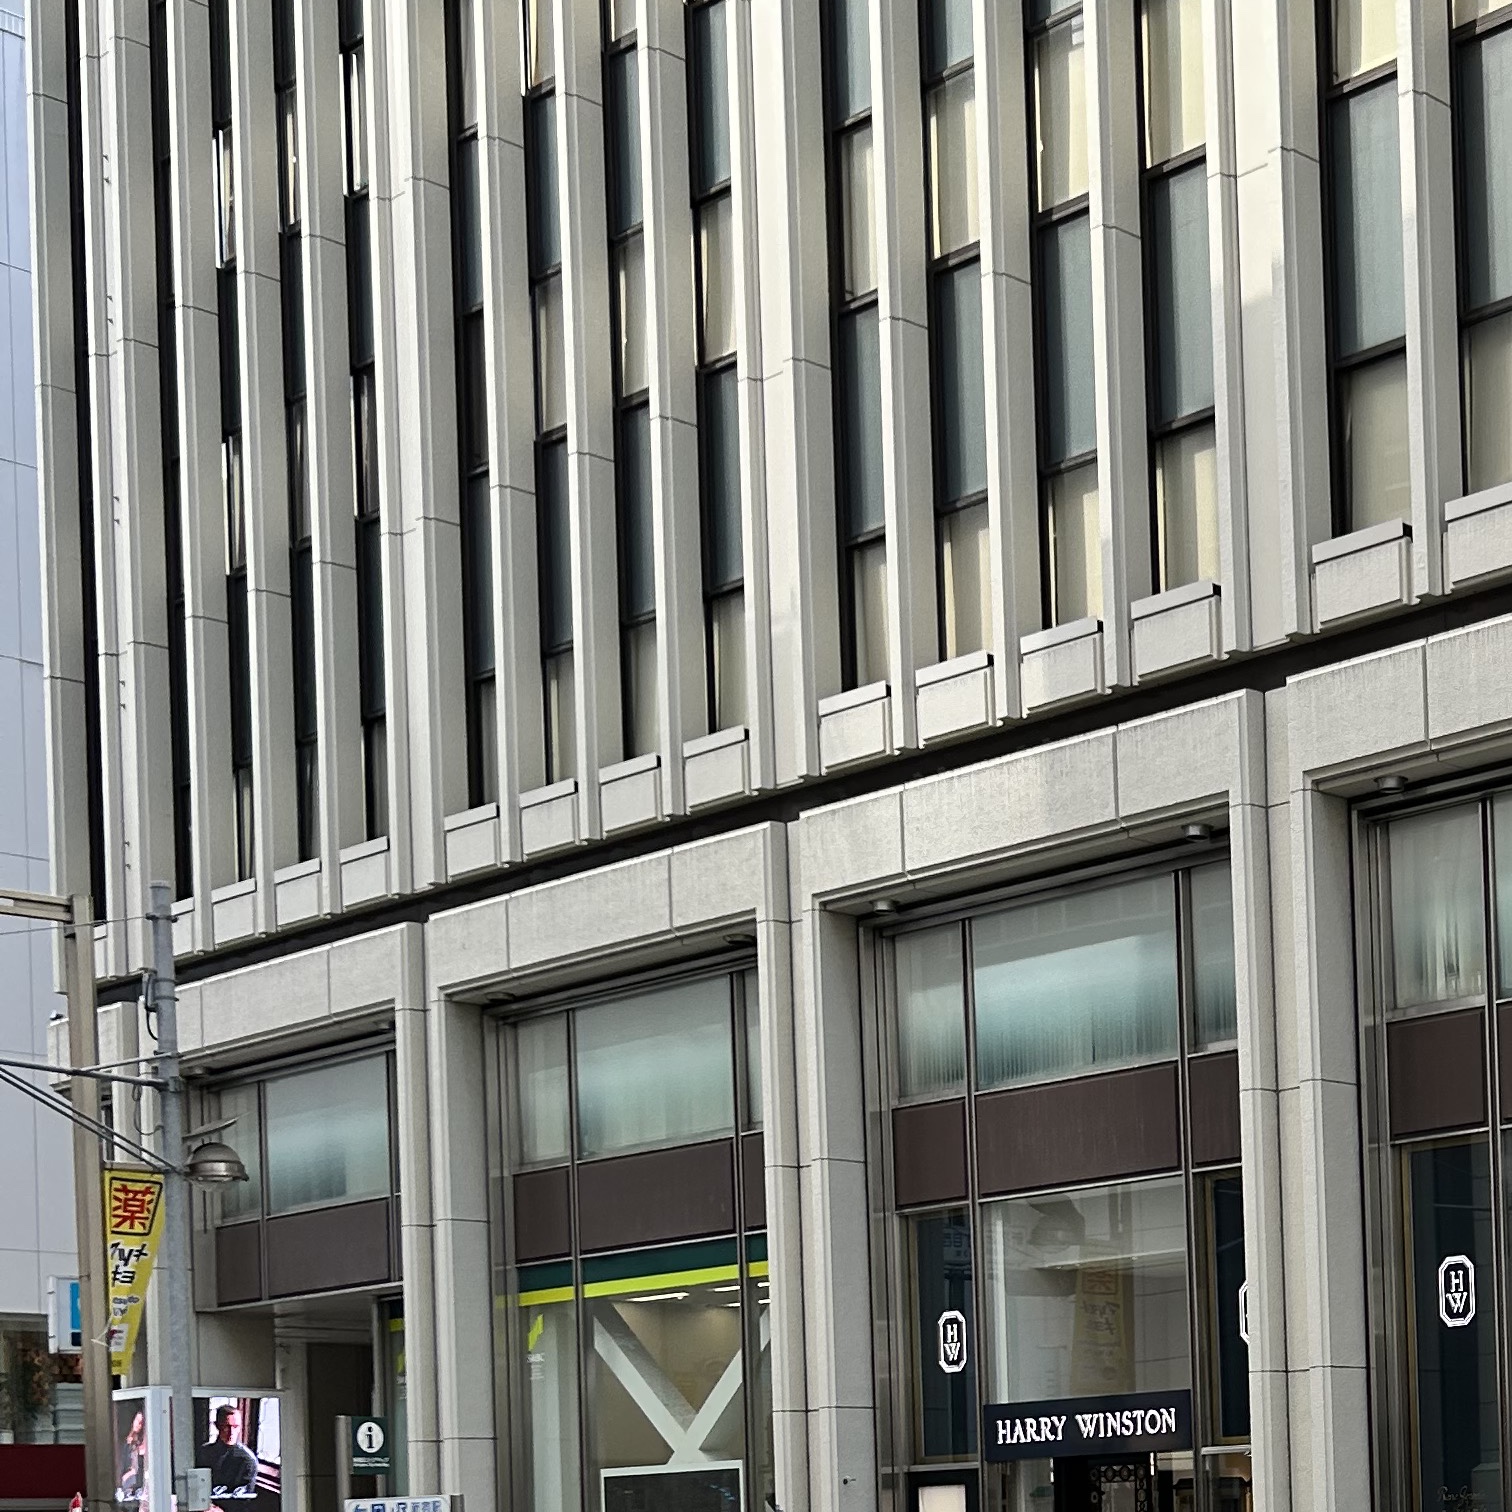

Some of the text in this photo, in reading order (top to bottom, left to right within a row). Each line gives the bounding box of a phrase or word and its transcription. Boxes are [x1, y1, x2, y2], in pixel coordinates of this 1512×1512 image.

[111, 1184, 155, 1230] 薬
[996, 1407, 1176, 1444] HARRY WINSTON
